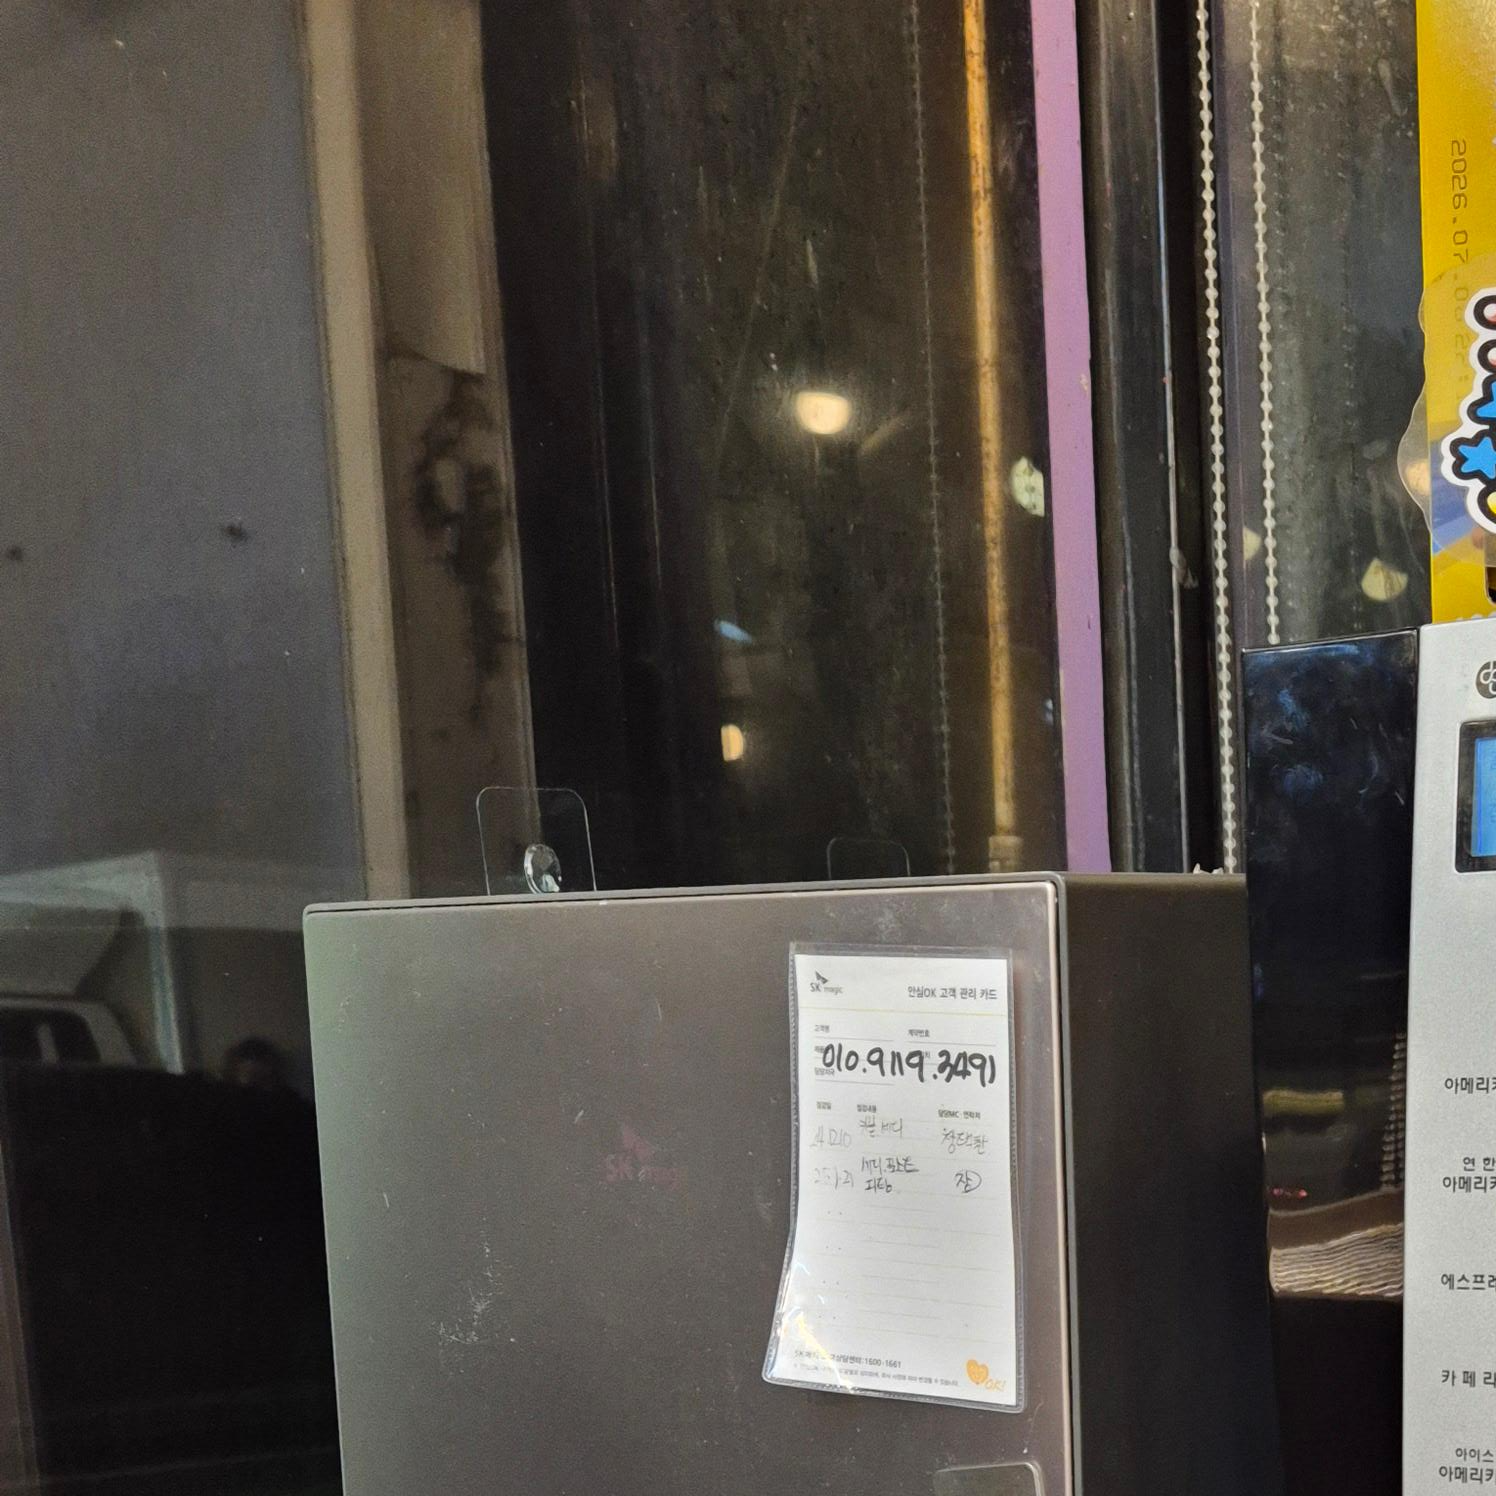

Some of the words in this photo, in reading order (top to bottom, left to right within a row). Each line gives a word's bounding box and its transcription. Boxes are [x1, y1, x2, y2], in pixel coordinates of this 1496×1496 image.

[940, 987, 956, 999] 고객
[960, 988, 976, 1000] 관리
[979, 988, 998, 1000] 카드
[1462, 1157, 1496, 1171] 연한
[1455, 1448, 1494, 1463] 아이스
